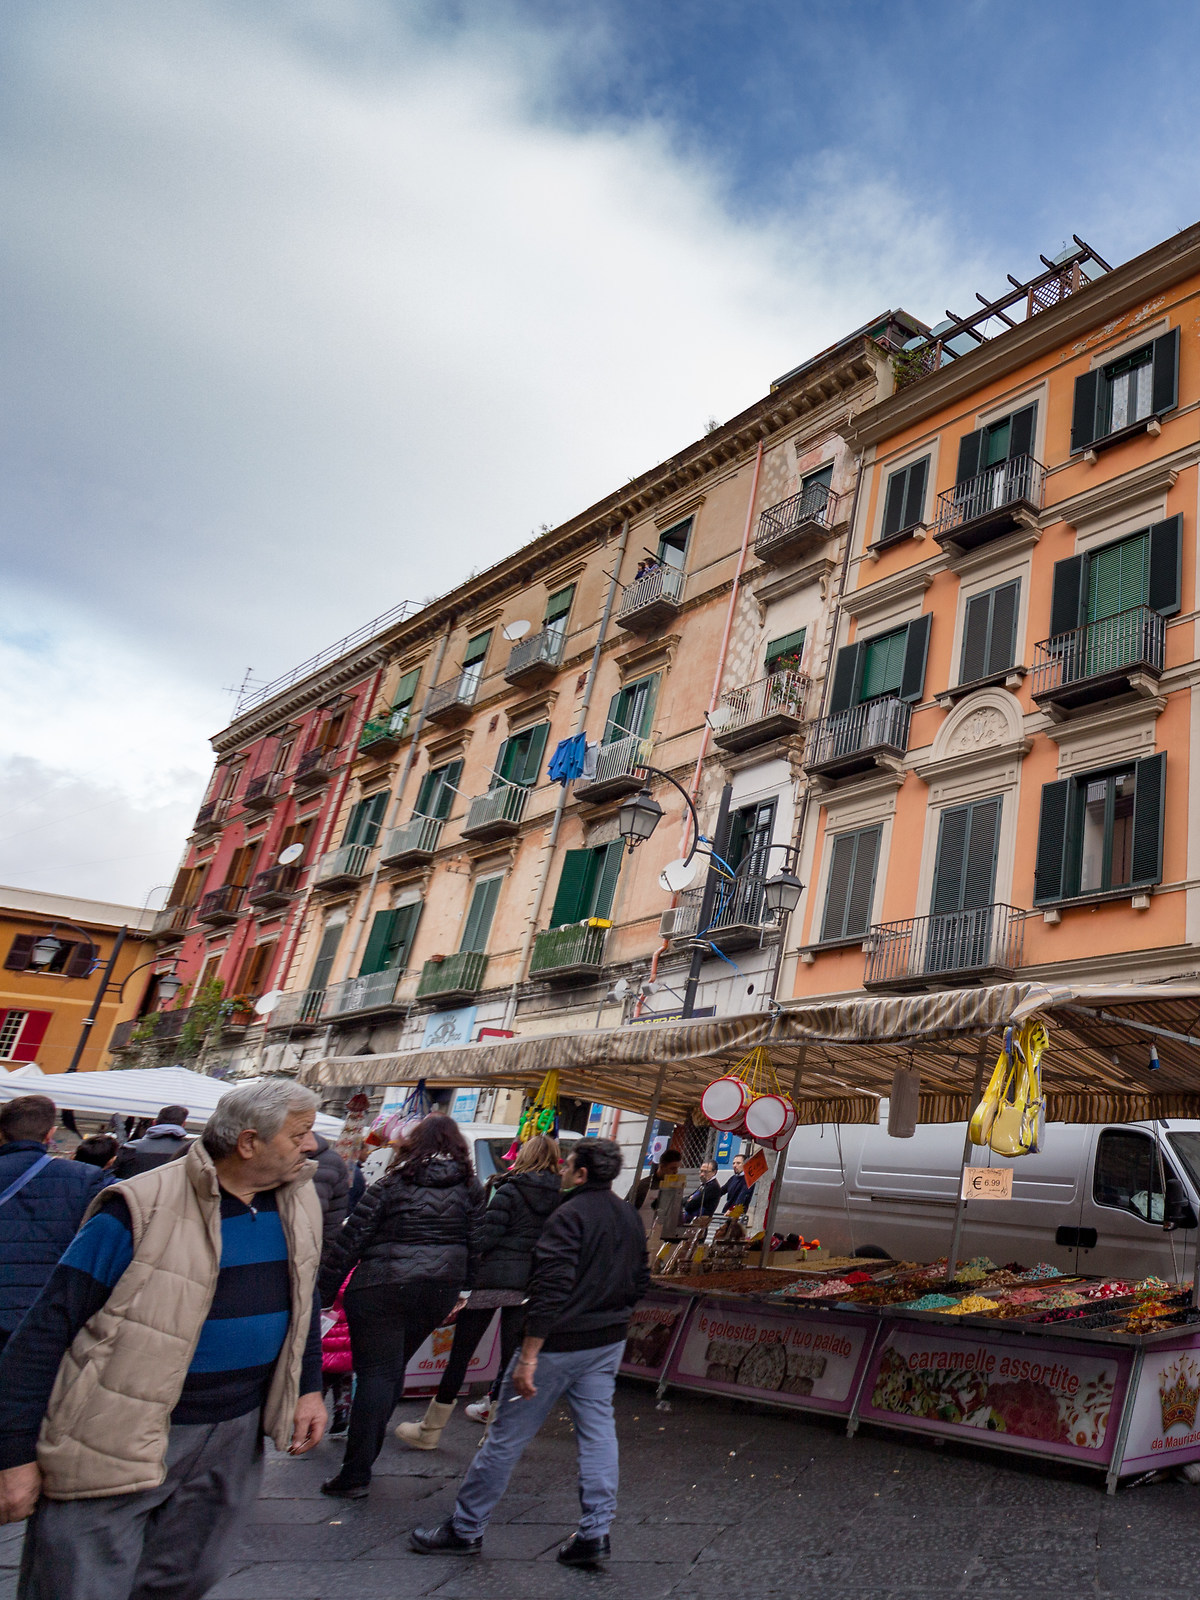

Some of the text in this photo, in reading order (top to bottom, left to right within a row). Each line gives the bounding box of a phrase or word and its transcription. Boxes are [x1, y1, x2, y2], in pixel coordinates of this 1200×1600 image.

[984, 1179, 1001, 1187] 6.99
[698, 1312, 852, 1358] le golosità per il tuo palato
[418, 1358, 434, 1369] da
[908, 1348, 1080, 1395] caramelle assortite
[1151, 1437, 1164, 1450] da
